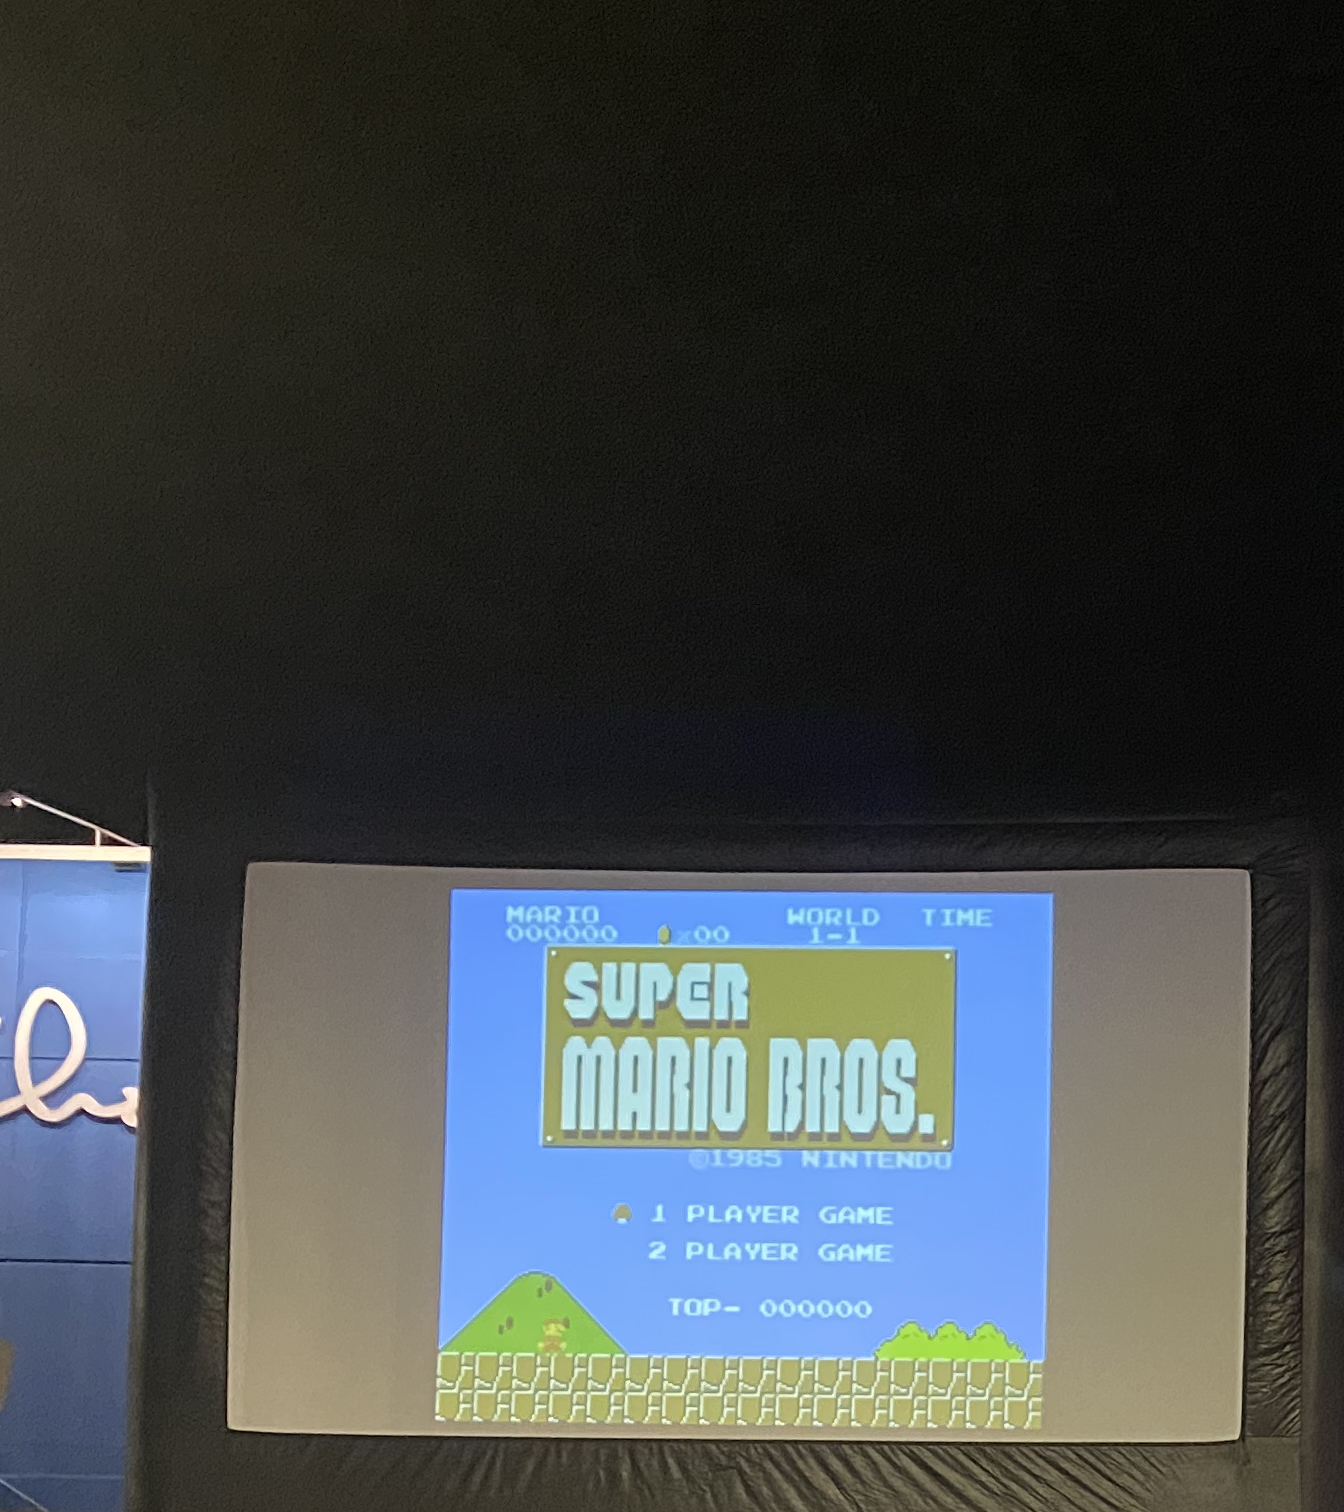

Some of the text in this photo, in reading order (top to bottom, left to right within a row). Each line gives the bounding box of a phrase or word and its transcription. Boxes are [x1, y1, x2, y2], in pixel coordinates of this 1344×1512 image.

[506, 905, 993, 927] MARIO WORLD TIME
[809, 927, 860, 944] 1-1
[563, 961, 750, 1023] SUPER
[561, 1035, 935, 1136] MARIO BROS.
[802, 1151, 952, 1170] NINTENDO
[651, 1204, 894, 1225] 1 PLAYER GAME
[648, 1241, 894, 1262] 2 PLAYER GAME
[669, 1298, 873, 1318] TOP- 000000
